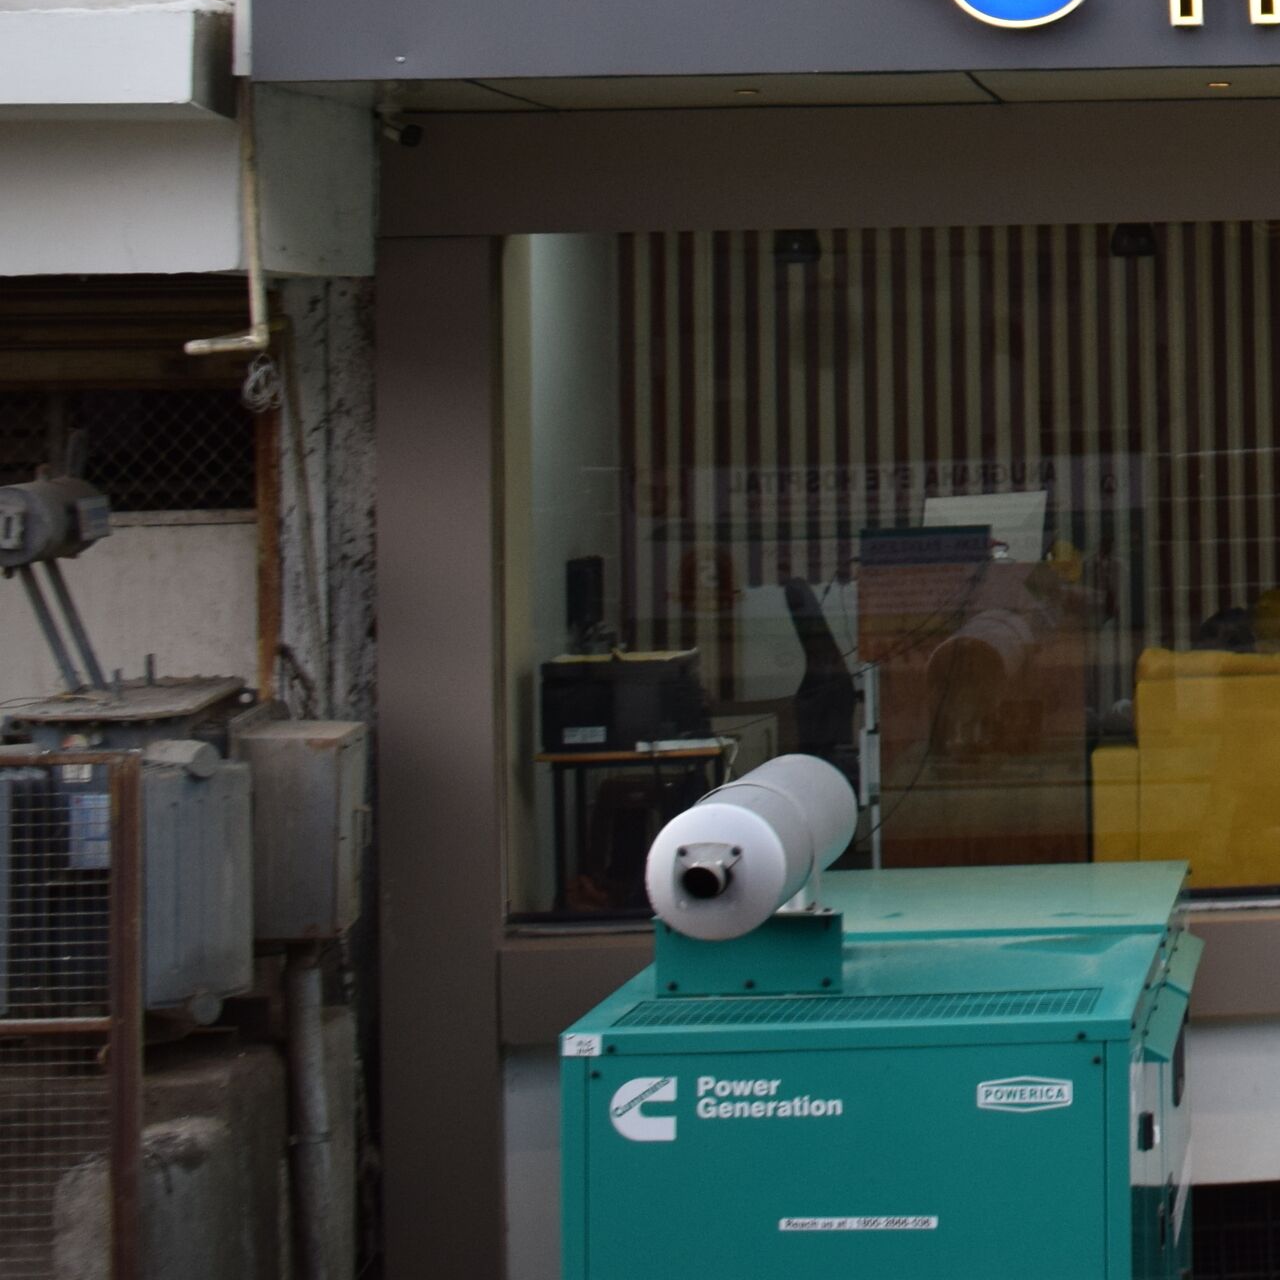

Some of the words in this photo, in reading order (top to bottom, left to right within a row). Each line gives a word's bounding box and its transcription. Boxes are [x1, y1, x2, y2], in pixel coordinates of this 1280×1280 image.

[697, 1075, 781, 1097] Power
[983, 1086, 1065, 1101] POWERICA
[697, 1095, 843, 1118] Generation
